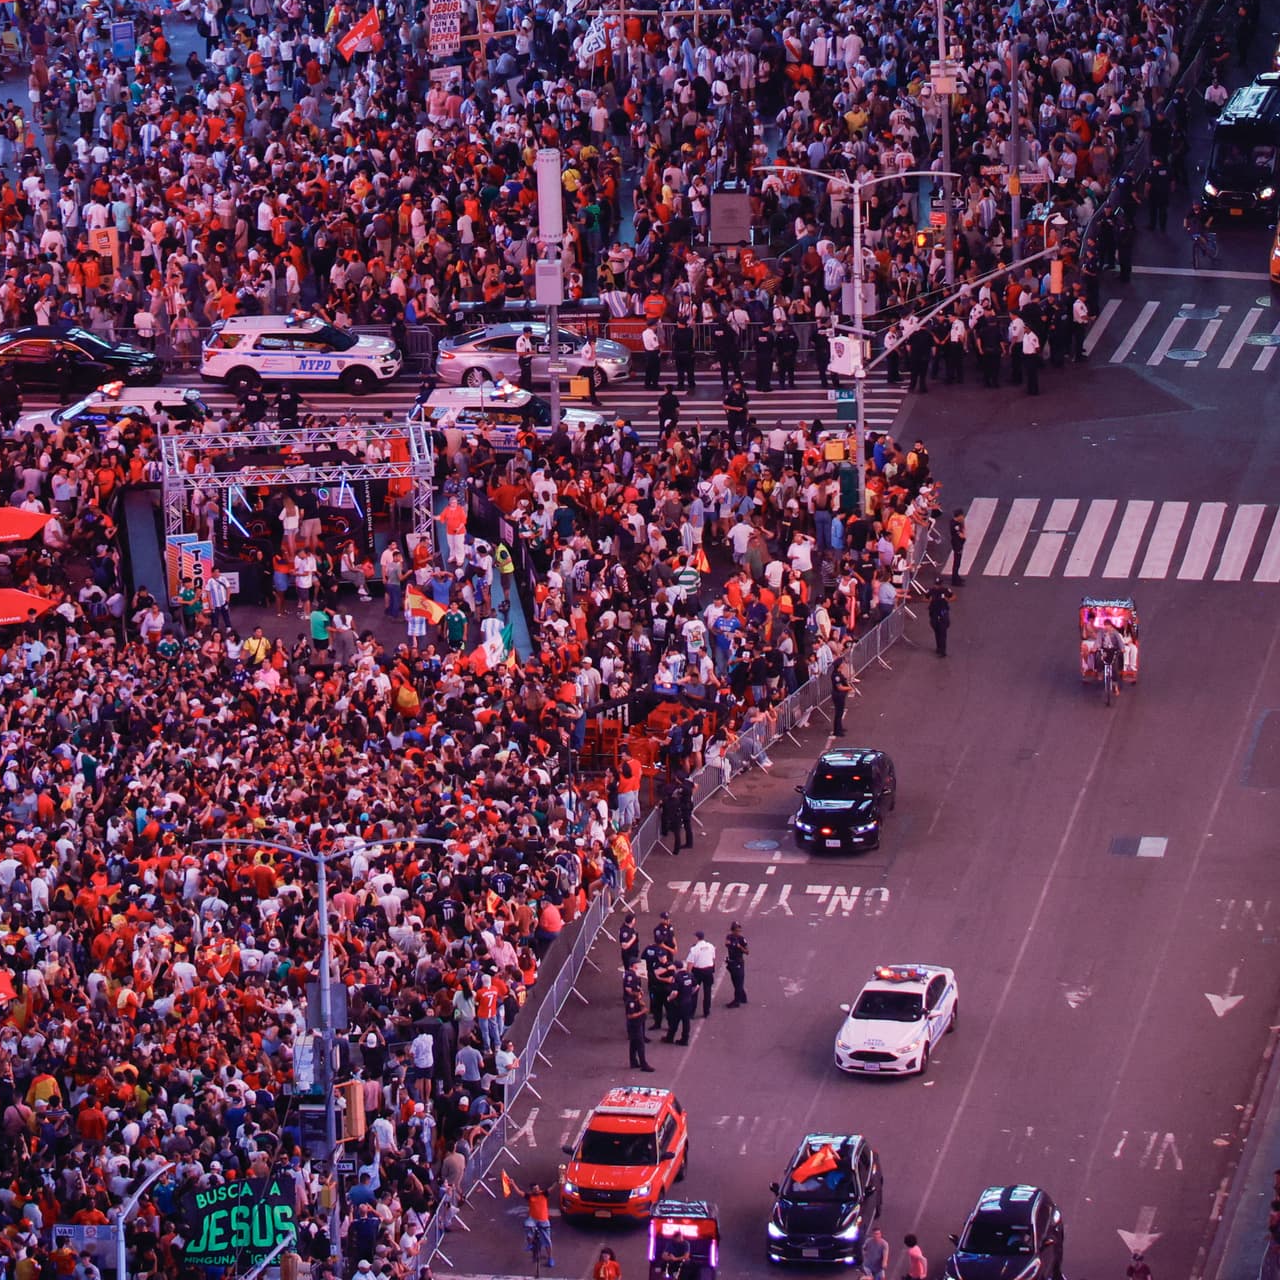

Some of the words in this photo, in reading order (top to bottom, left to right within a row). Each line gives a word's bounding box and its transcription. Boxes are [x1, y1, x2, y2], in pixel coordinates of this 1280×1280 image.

[431, 1, 459, 14] JESUS
[431, 26, 457, 34] SAVES
[299, 359, 332, 371] NYPD
[761, 883, 890, 917] ONLY
[195, 1181, 253, 1209] BUSCA
[270, 1181, 281, 1196] A
[185, 1198, 298, 1254] JESÚS
[184, 1253, 238, 1265] NINGUNA
